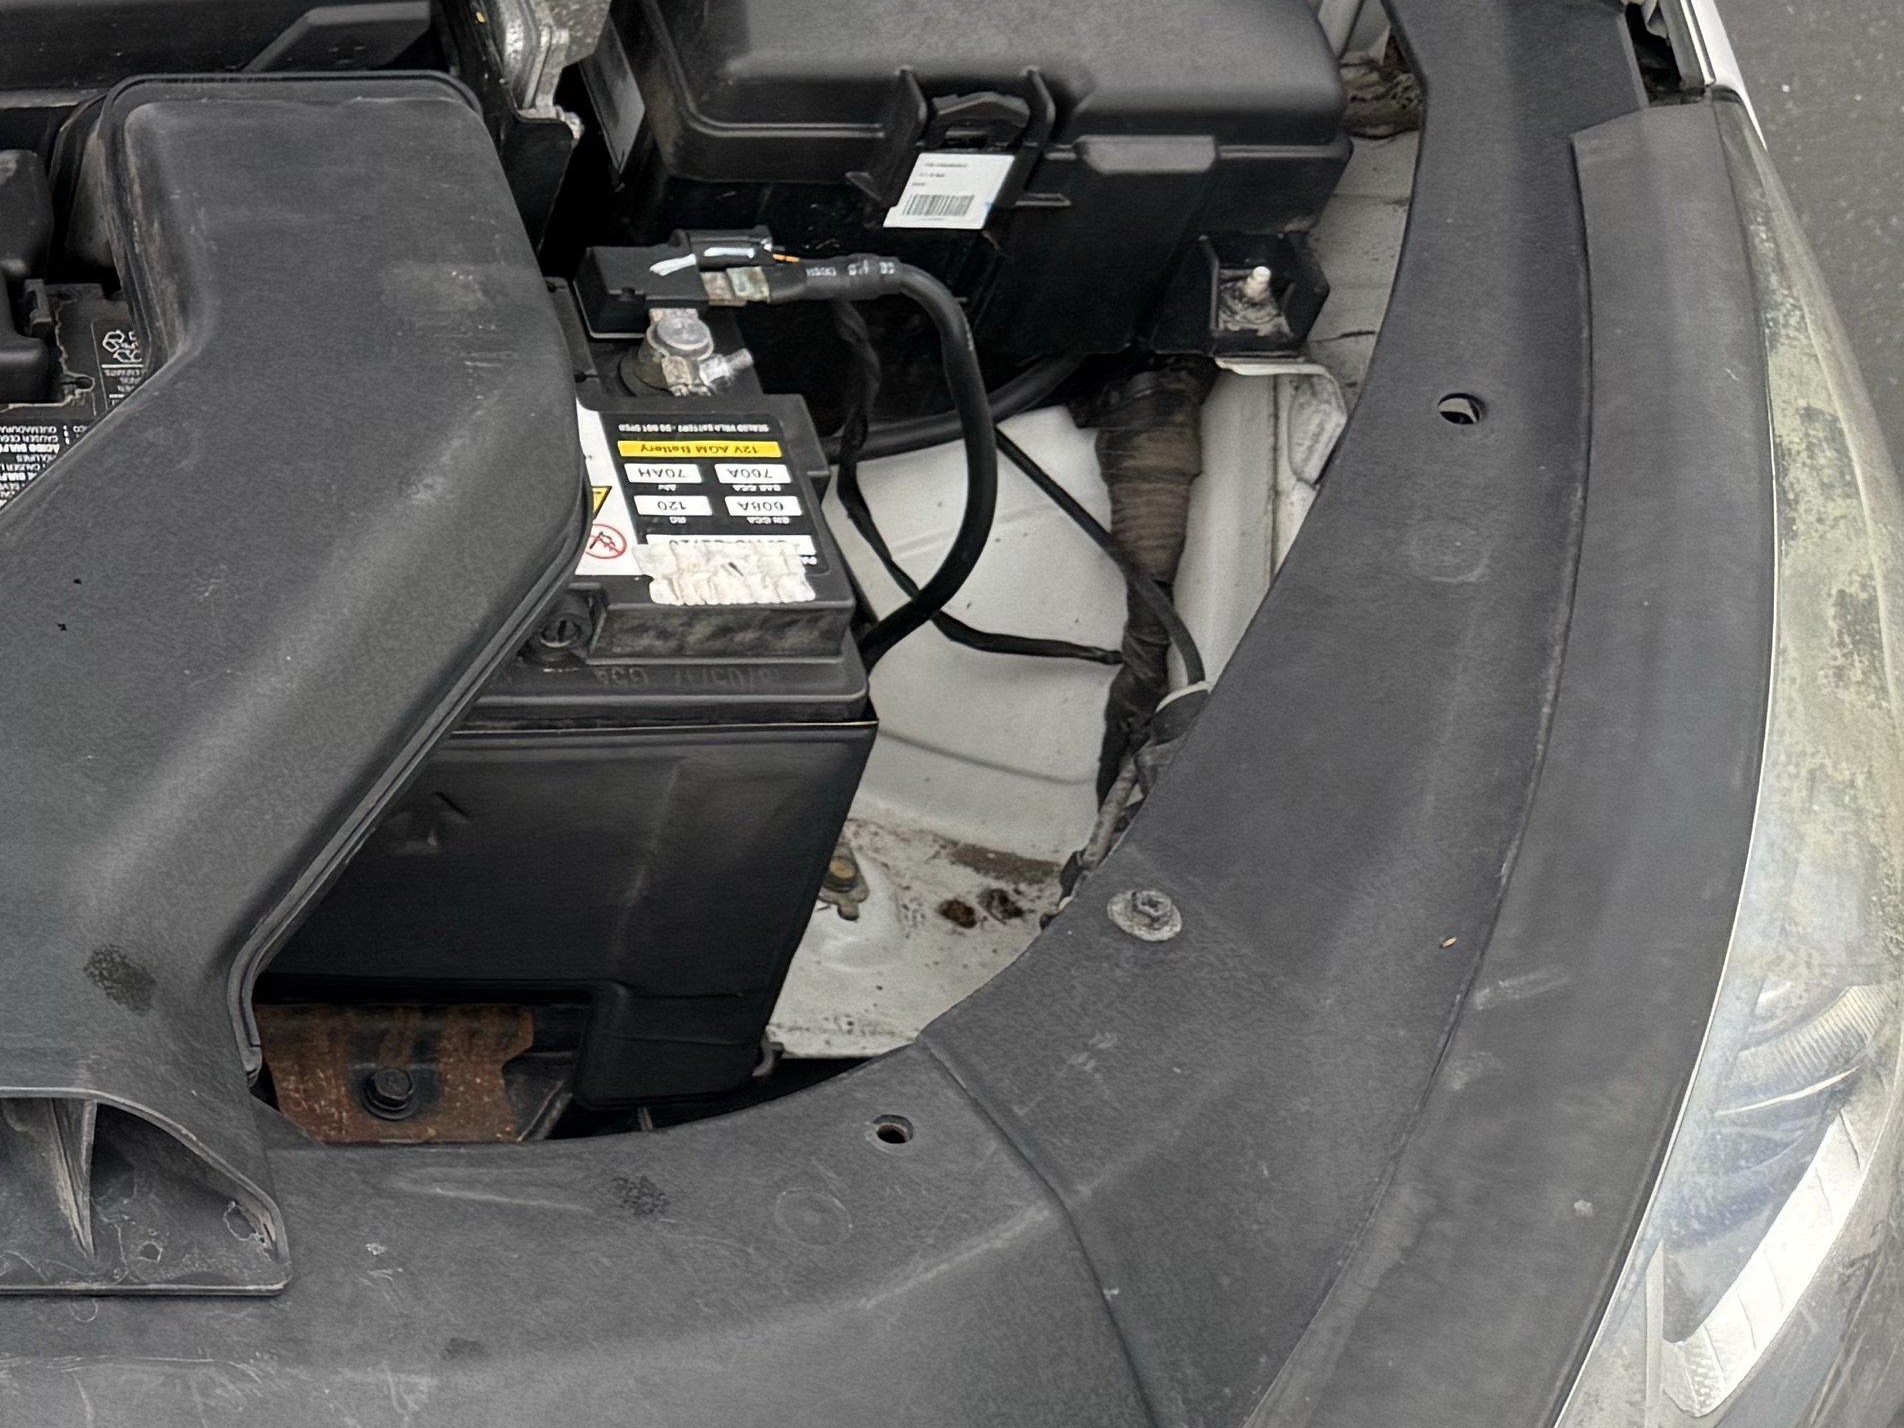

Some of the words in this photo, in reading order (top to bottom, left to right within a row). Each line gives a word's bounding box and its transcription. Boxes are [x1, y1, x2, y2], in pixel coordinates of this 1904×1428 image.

[640, 444, 691, 454] Battery
[735, 445, 758, 454] 12V
[638, 468, 687, 478] 70AH
